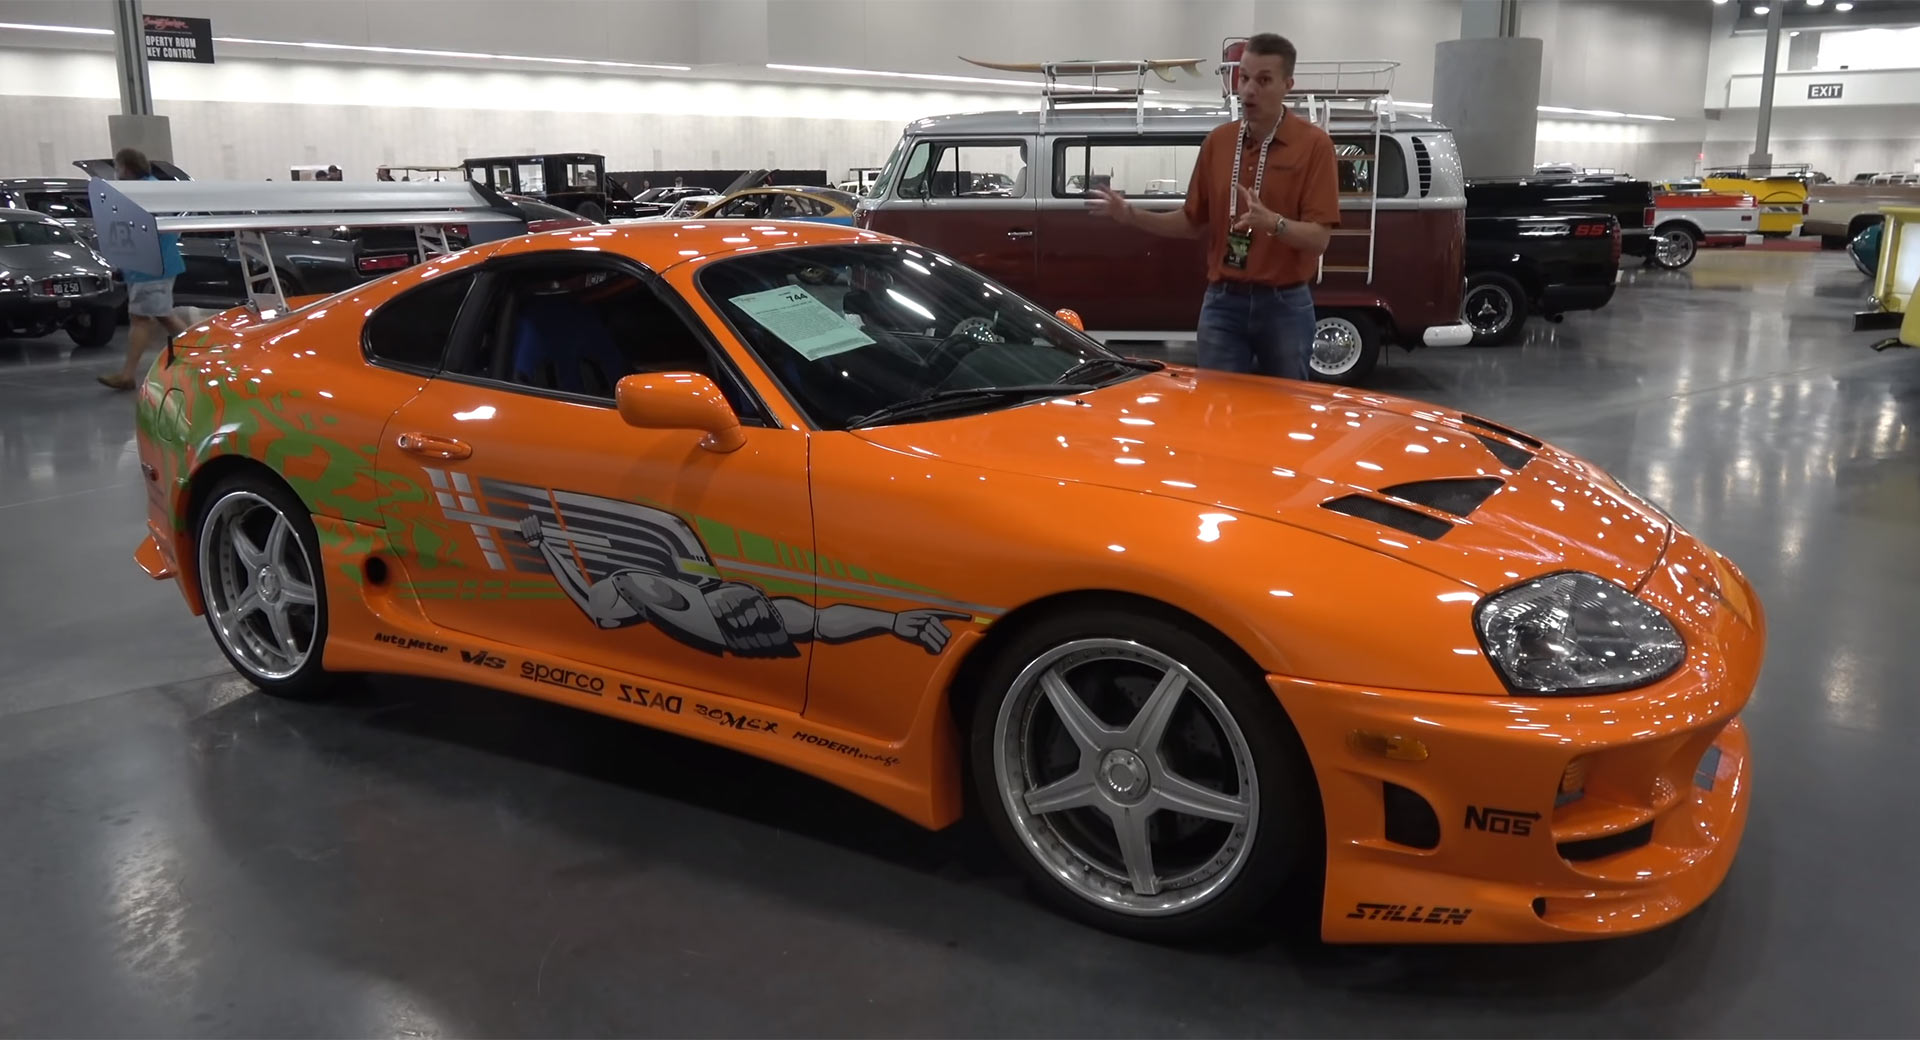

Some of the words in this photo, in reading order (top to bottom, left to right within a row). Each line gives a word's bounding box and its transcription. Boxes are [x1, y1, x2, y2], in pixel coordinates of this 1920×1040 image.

[145, 35, 173, 47] OPERTY
[175, 37, 196, 48] ROOM
[147, 47, 161, 57] KEY
[162, 48, 196, 59] CONTROL
[1811, 86, 1841, 97] EXIT
[1575, 224, 1605, 236] SS
[786, 293, 808, 302] 744
[520, 661, 604, 696] sparco
[1464, 805, 1542, 836] NOS
[1346, 902, 1472, 925] STILLEN
